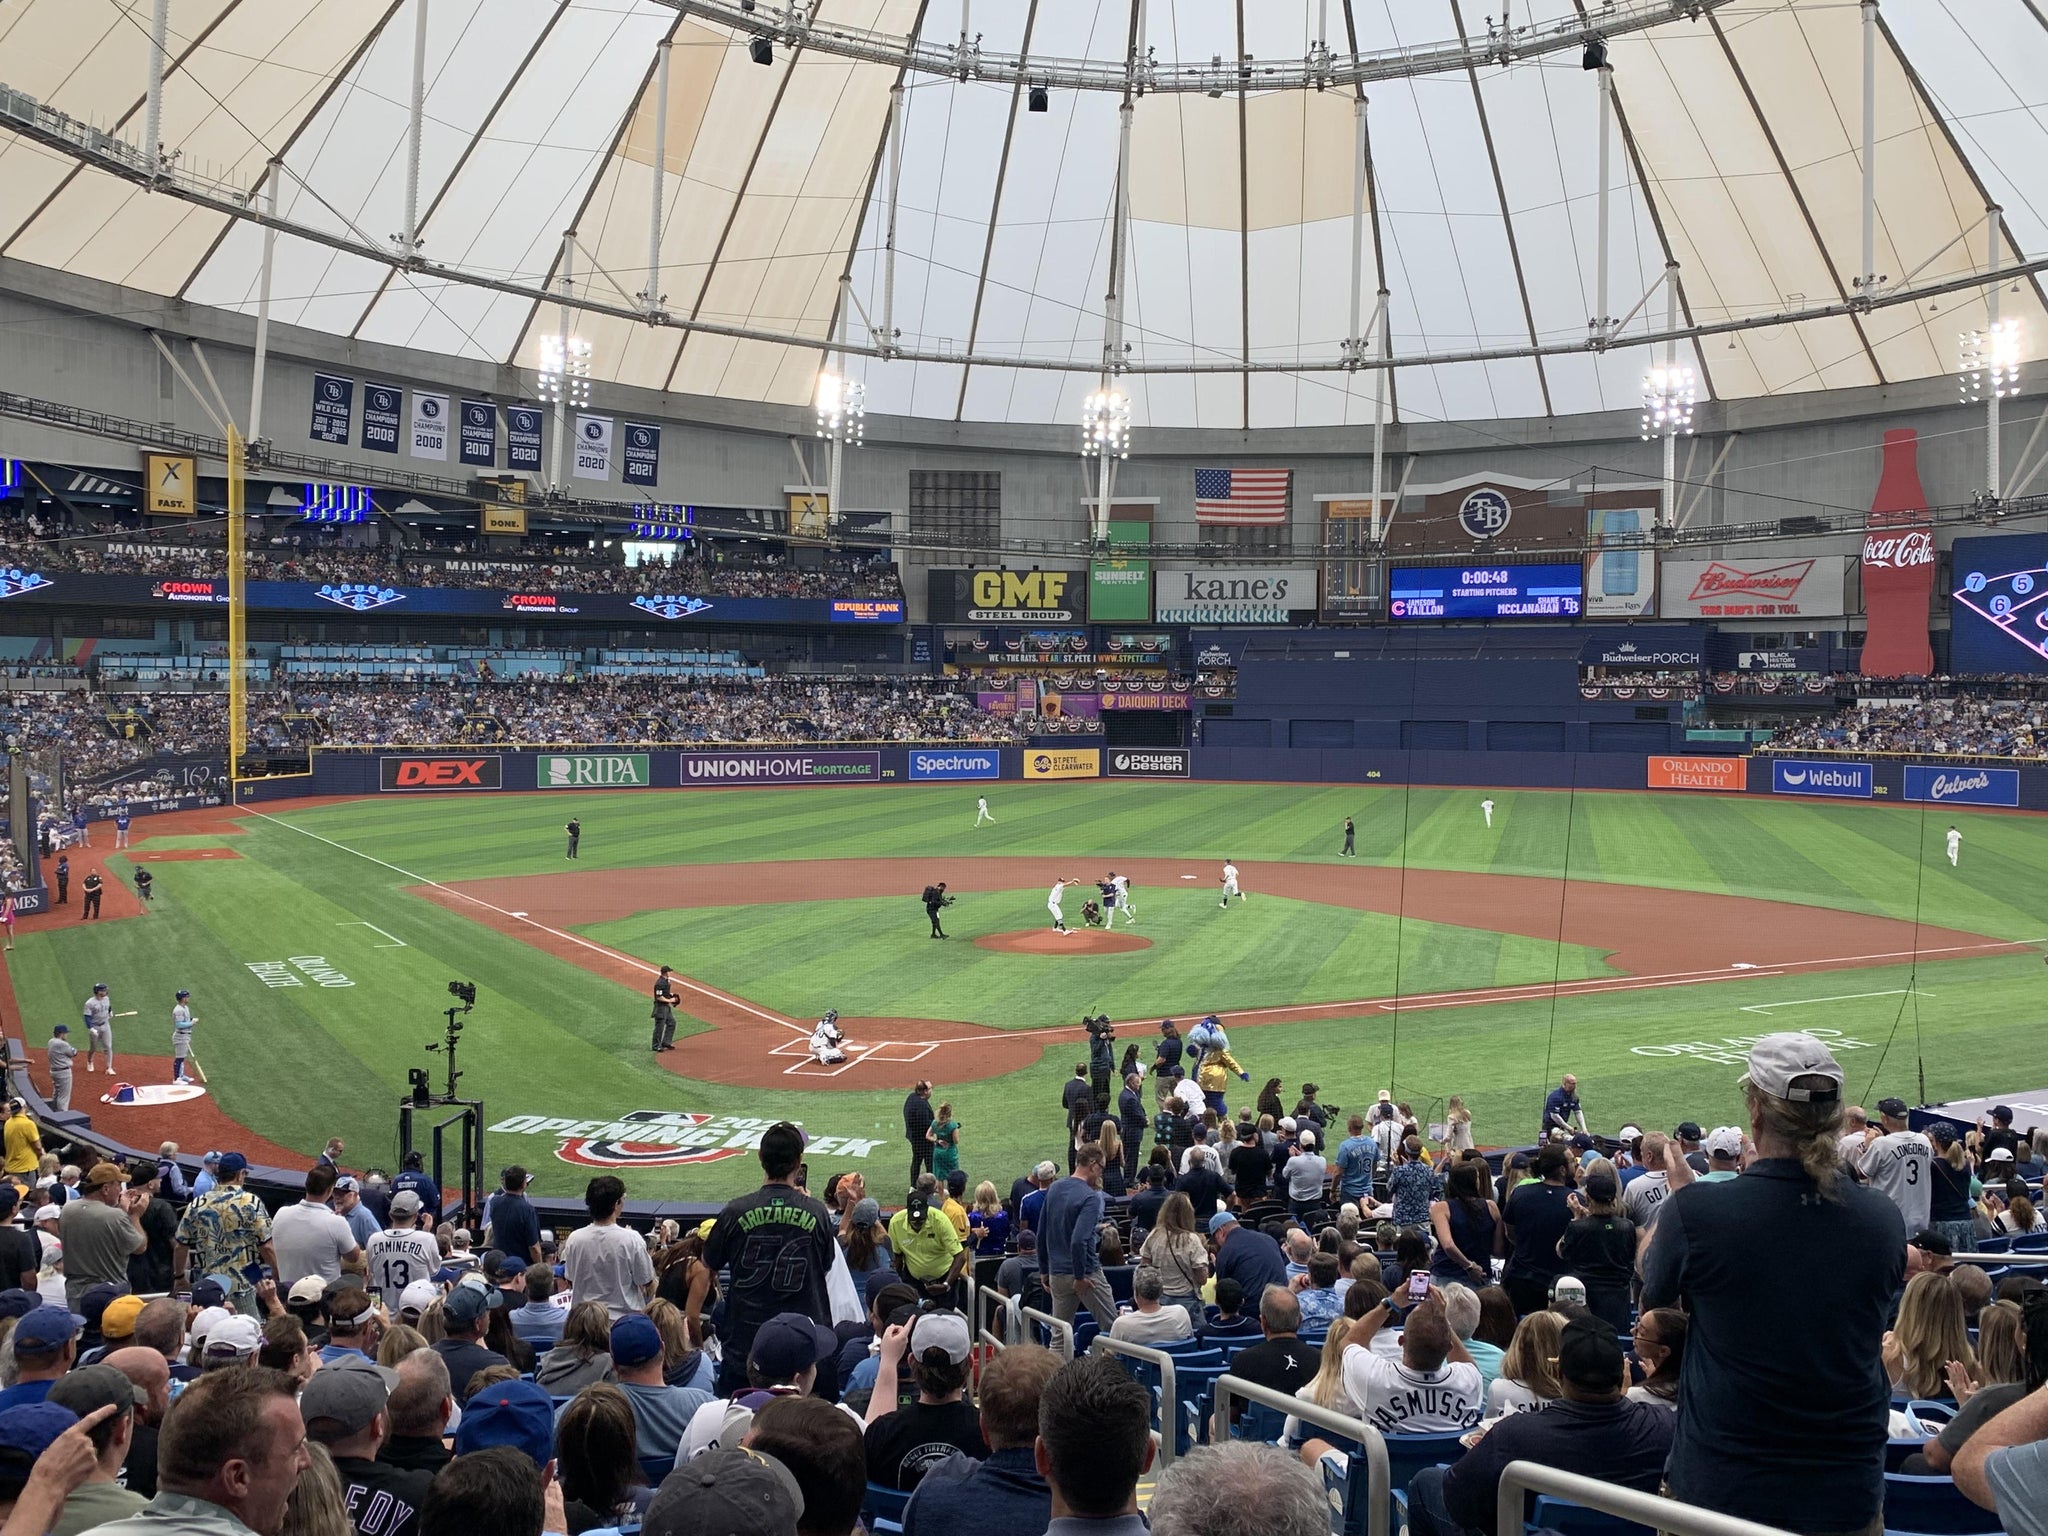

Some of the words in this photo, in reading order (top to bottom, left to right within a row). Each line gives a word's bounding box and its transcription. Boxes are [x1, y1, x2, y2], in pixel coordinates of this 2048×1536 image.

[315, 403, 331, 413] WILD
[332, 406, 348, 416] CARD
[332, 419, 346, 428] 2013
[365, 413, 398, 425] CHAMPIONS
[332, 427, 347, 436] 2022
[413, 421, 446, 433] CHAMPIONS
[321, 432, 337, 442] 2023
[367, 426, 395, 442] 2008
[462, 428, 494, 440] CHAMPIONS
[509, 434, 541, 445] CHAMPIONS
[416, 435, 442, 449] 2008
[577, 443, 608, 454] CHAMPIONS
[465, 442, 490, 456] 2010
[512, 447, 538, 461] 2020
[625, 450, 657, 461] CHAMPIONS
[578, 456, 604, 470] 2020
[629, 463, 652, 476] 2021
[158, 500, 185, 509] FAST.
[490, 520, 519, 528] DONE.
[1862, 531, 1936, 568] Coca-Cola
[1461, 571, 1509, 585] 0:00:48
[1701, 572, 1800, 592] Budweiser
[1970, 576, 1981, 589] 7
[2017, 577, 2028, 591] 5
[161, 582, 213, 593] CROWN
[973, 571, 1068, 608] GMF
[1184, 572, 1288, 601] kane's
[1452, 588, 1484, 597] STARTING
[1485, 587, 1518, 596] PITCHERS
[511, 595, 556, 605] CROWN
[1538, 596, 1560, 604] SHANE
[1994, 598, 2005, 612] 6
[834, 602, 874, 612] REPUBLIC
[875, 603, 899, 612] BANK
[1407, 605, 1443, 616] TAILLON
[1497, 603, 1560, 614] MCCLANAHAN
[1699, 605, 1722, 615] THIS
[1724, 605, 1754, 615] BUD'S
[1756, 605, 1776, 614] FOR
[1778, 604, 1801, 614] YOU.
[976, 611, 1017, 620] STEEL
[1022, 611, 1065, 620] GROUP
[988, 653, 999, 663] WE
[1006, 653, 1020, 662] THE
[1020, 653, 1039, 662] RAYS.
[1039, 653, 1050, 663] WE
[1197, 656, 1231, 666] PORCH
[1601, 652, 1653, 662] Budweiser
[1652, 653, 1700, 664] PORCH
[1118, 695, 1160, 709] DAIQUIRI
[1162, 696, 1188, 709] DECK
[573, 756, 641, 785] RIPA
[813, 764, 872, 775] MORTGAGE
[916, 754, 986, 775] Spectrum
[1053, 762, 1094, 772] CLEARWATER
[1662, 759, 1733, 774] ORLANDO
[181, 766, 210, 786] 162
[395, 760, 487, 786] DEX
[882, 769, 895, 777] 378
[1670, 772, 1727, 786] HEALTH
[1809, 769, 1862, 789] Webull
[1873, 786, 1888, 795] 382
[1931, 771, 1990, 800] Culver's
[487, 1115, 730, 1148] OPENING
[721, 1129, 888, 1158] WEK
[1890, 1142, 1930, 1161] LONGORIA
[1358, 1157, 1373, 1174] 13
[1906, 1159, 1919, 1186] 3
[397, 1181, 418, 1189] SECURITY
[737, 1206, 817, 1233] AROZARENA
[373, 1240, 422, 1256] CAMINERO
[733, 1234, 812, 1292] 56
[381, 1259, 410, 1290] 13
